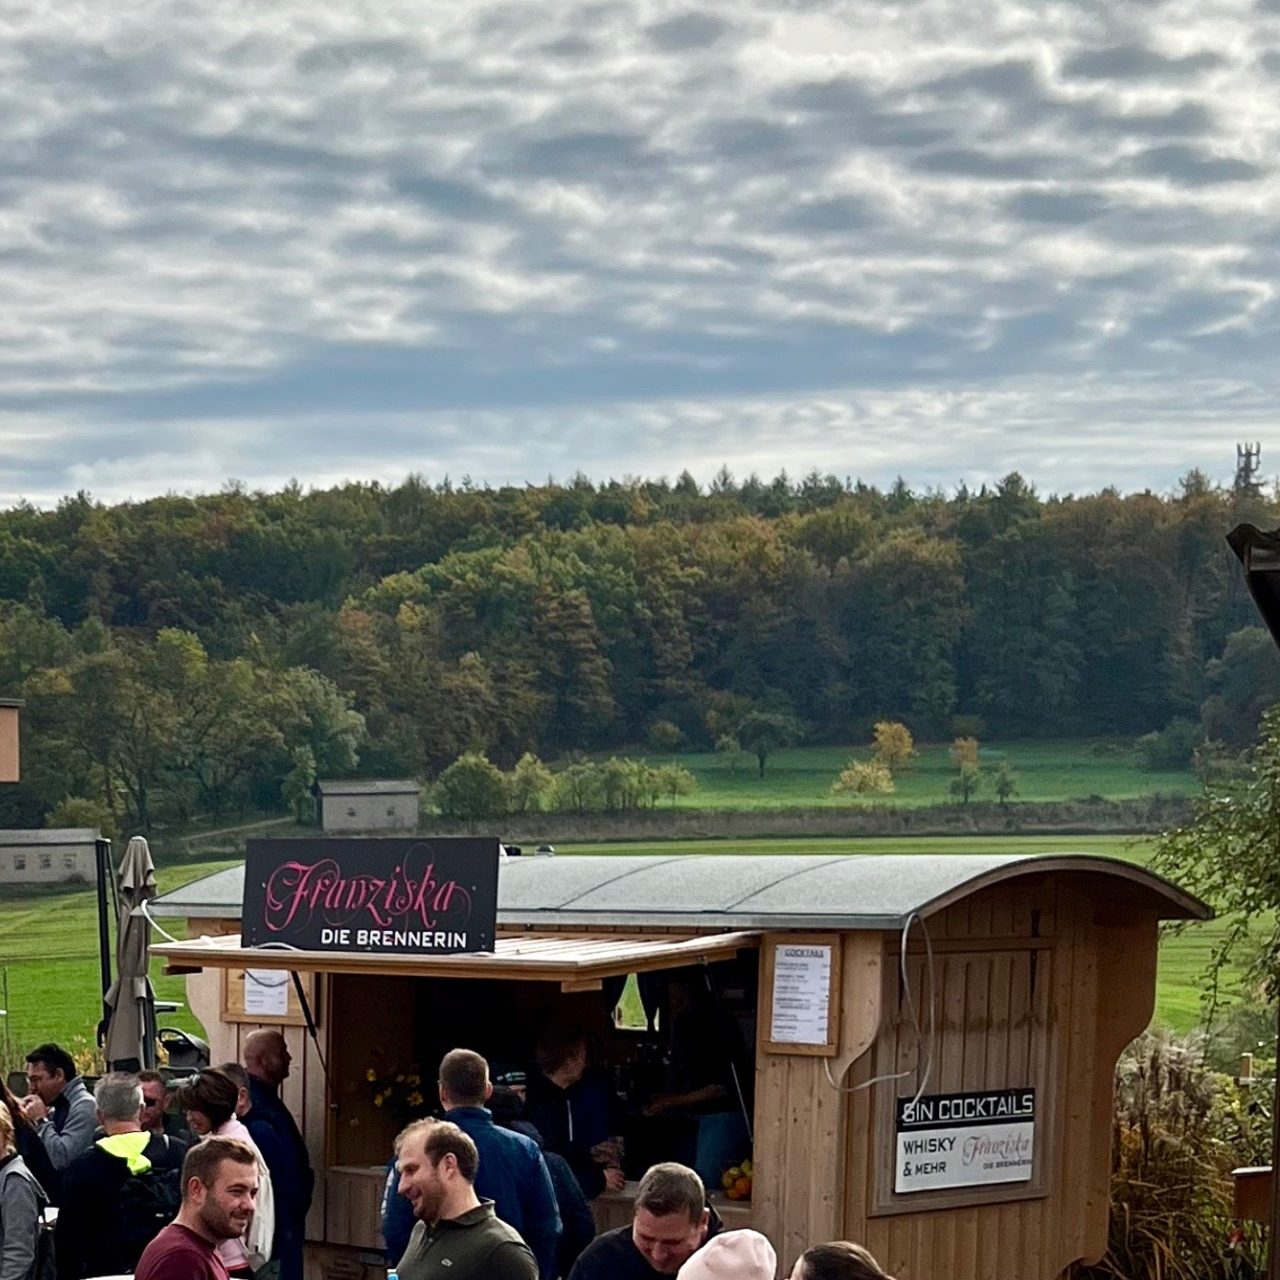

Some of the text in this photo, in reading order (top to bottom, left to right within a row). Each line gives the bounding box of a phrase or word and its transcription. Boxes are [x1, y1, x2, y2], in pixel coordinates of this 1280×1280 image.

[265, 845, 470, 932] Franziska
[321, 928, 467, 949] DIE BRENNERIN
[902, 1094, 1034, 1122] GIN COCKTAILS
[903, 1137, 956, 1155] WHISKY
[903, 1161, 947, 1177] & MEHR
